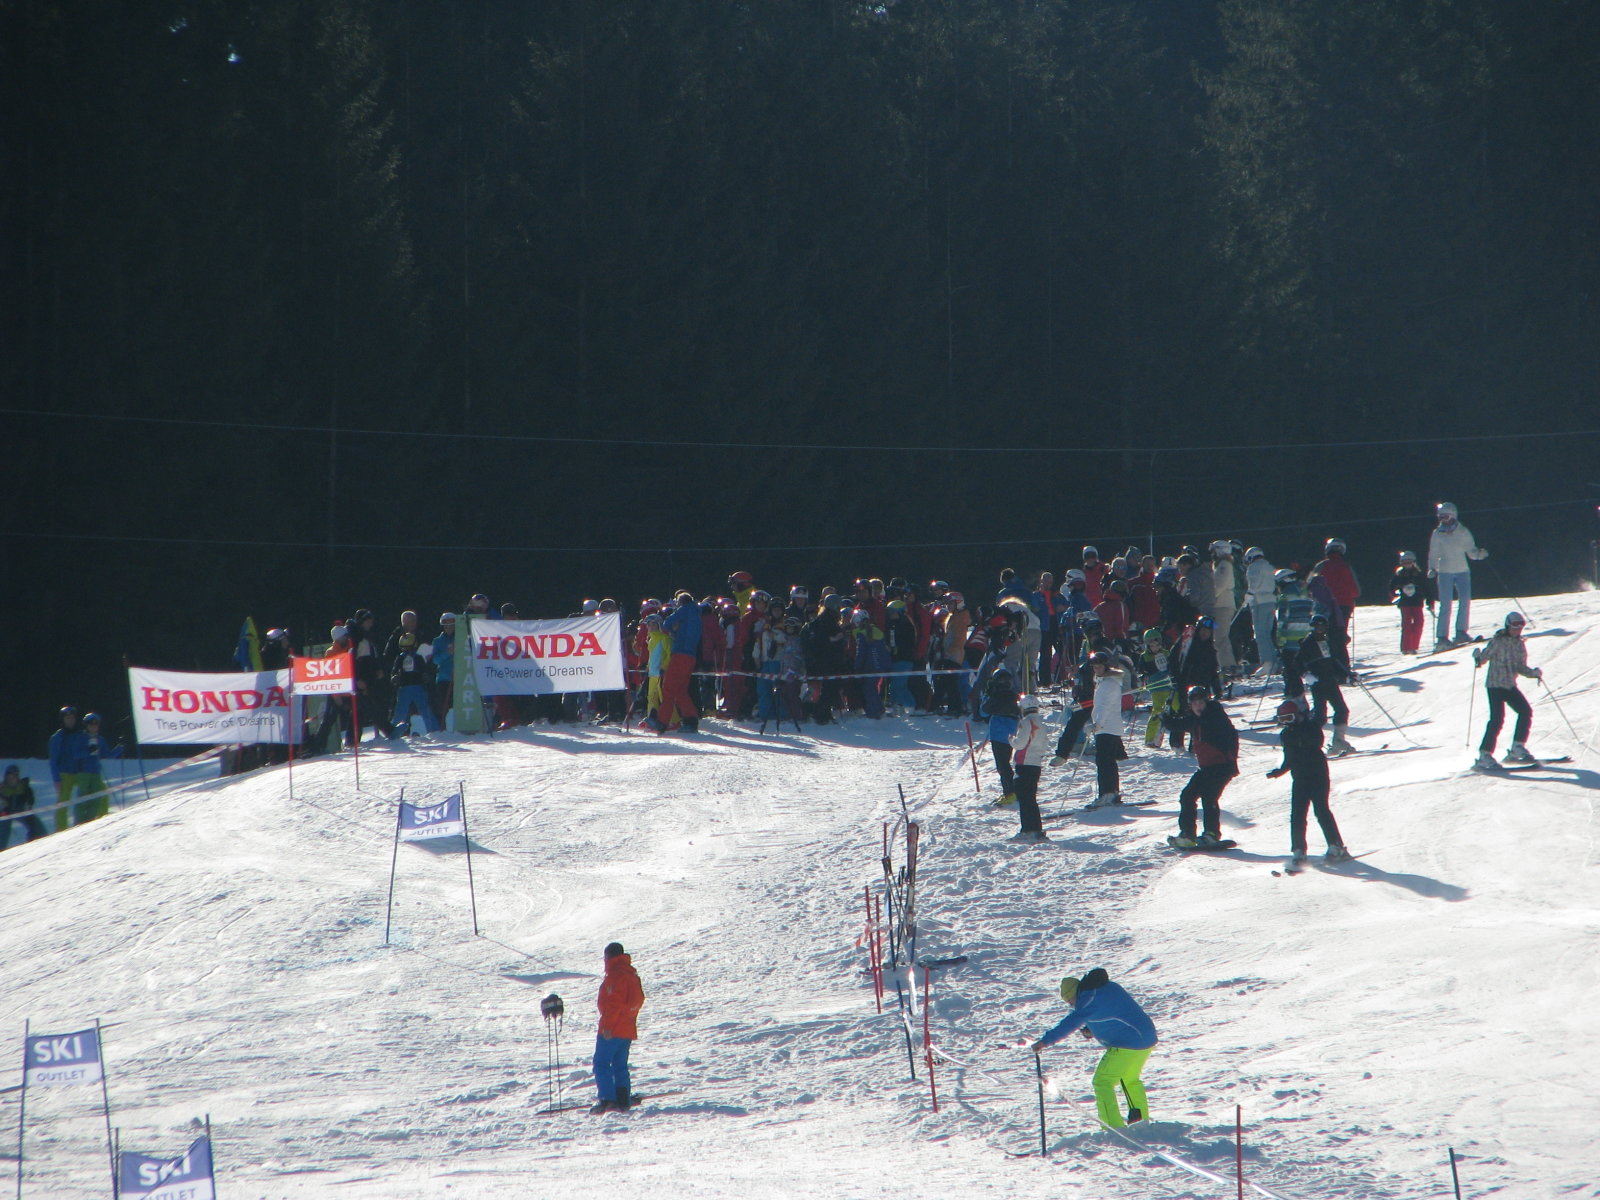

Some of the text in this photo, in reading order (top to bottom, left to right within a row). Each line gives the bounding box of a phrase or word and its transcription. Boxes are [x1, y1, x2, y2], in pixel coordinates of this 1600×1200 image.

[477, 632, 606, 660] HONDA
[305, 658, 341, 678] SKI
[485, 665, 594, 679] The Power of Dreams
[303, 683, 343, 691] OUTLET
[141, 686, 288, 714] HONDA
[155, 716, 275, 730] The Power of Dreams
[414, 802, 448, 825] SKI
[34, 1035, 82, 1063] SKI
[36, 1069, 85, 1082] OUTLET
